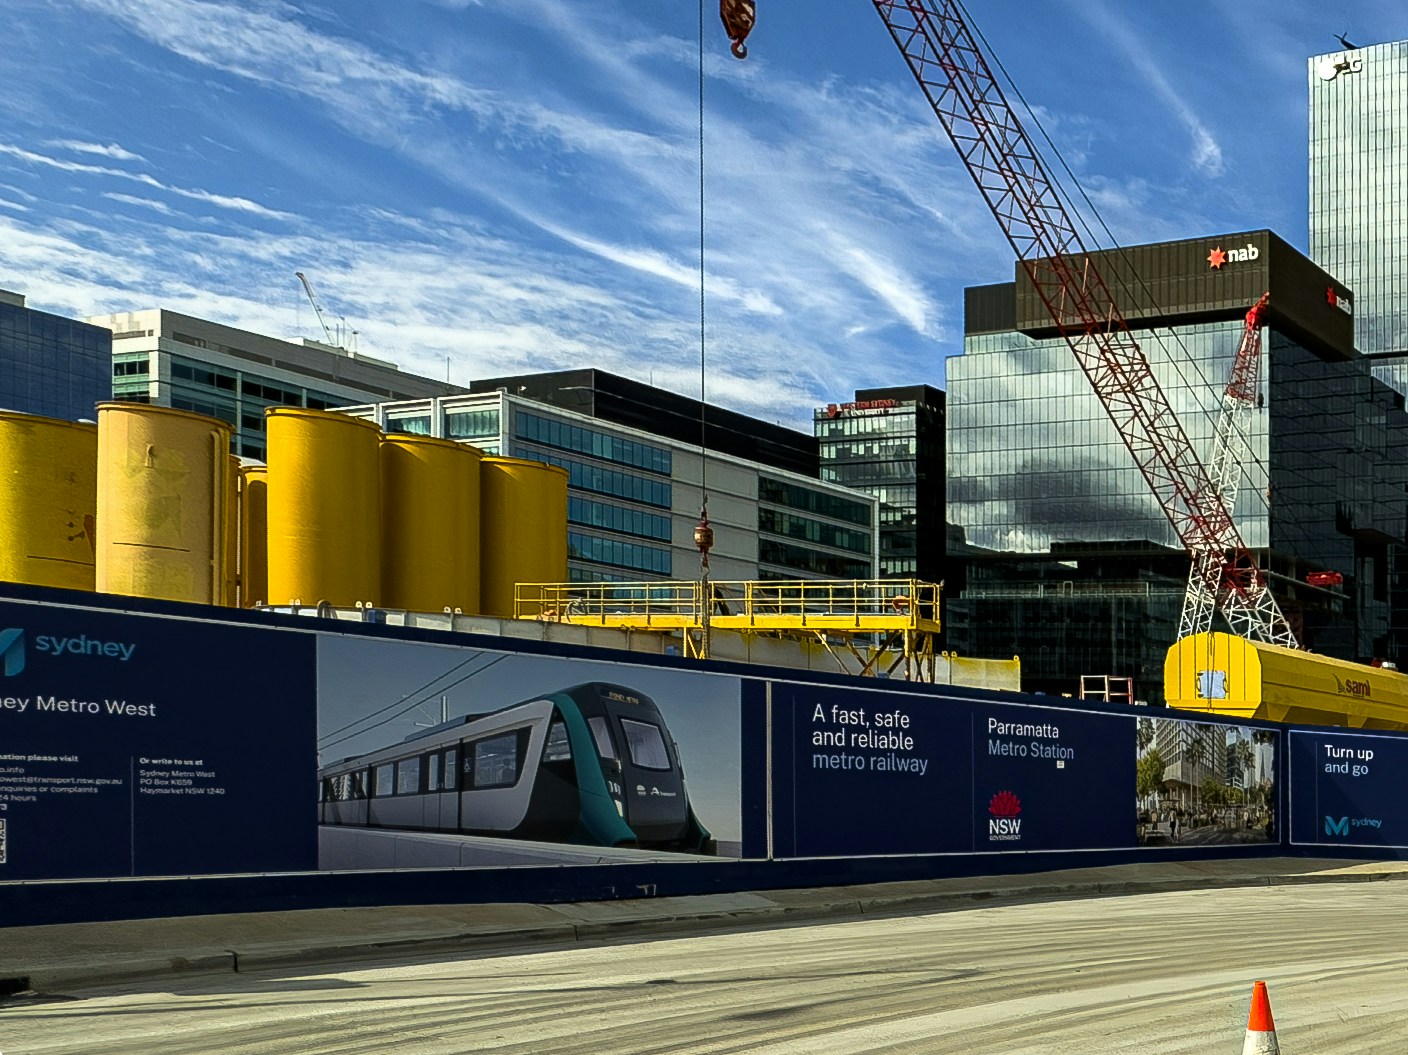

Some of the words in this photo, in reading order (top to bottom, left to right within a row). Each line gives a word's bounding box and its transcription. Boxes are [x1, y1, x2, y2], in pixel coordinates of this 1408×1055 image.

[1228, 244, 1259, 262] nab
[35, 634, 136, 661] sydney
[36, 695, 100, 713] Metro
[105, 699, 156, 717] West
[812, 703, 826, 723] A
[831, 704, 870, 729] fast,
[875, 710, 910, 729] safe
[812, 727, 846, 746] and
[851, 729, 914, 750] reliable
[988, 717, 1059, 739] Parramatta
[988, 739, 1028, 757] Metro
[1030, 741, 1075, 759] Station
[1324, 744, 1354, 759] Turn
[1357, 749, 1374, 762] up
[812, 752, 866, 770] metro
[870, 752, 929, 776] railway
[1324, 761, 1349, 773] and
[1352, 764, 1369, 777] go
[989, 818, 1022, 835] NSW
[1351, 817, 1383, 829] sydney
